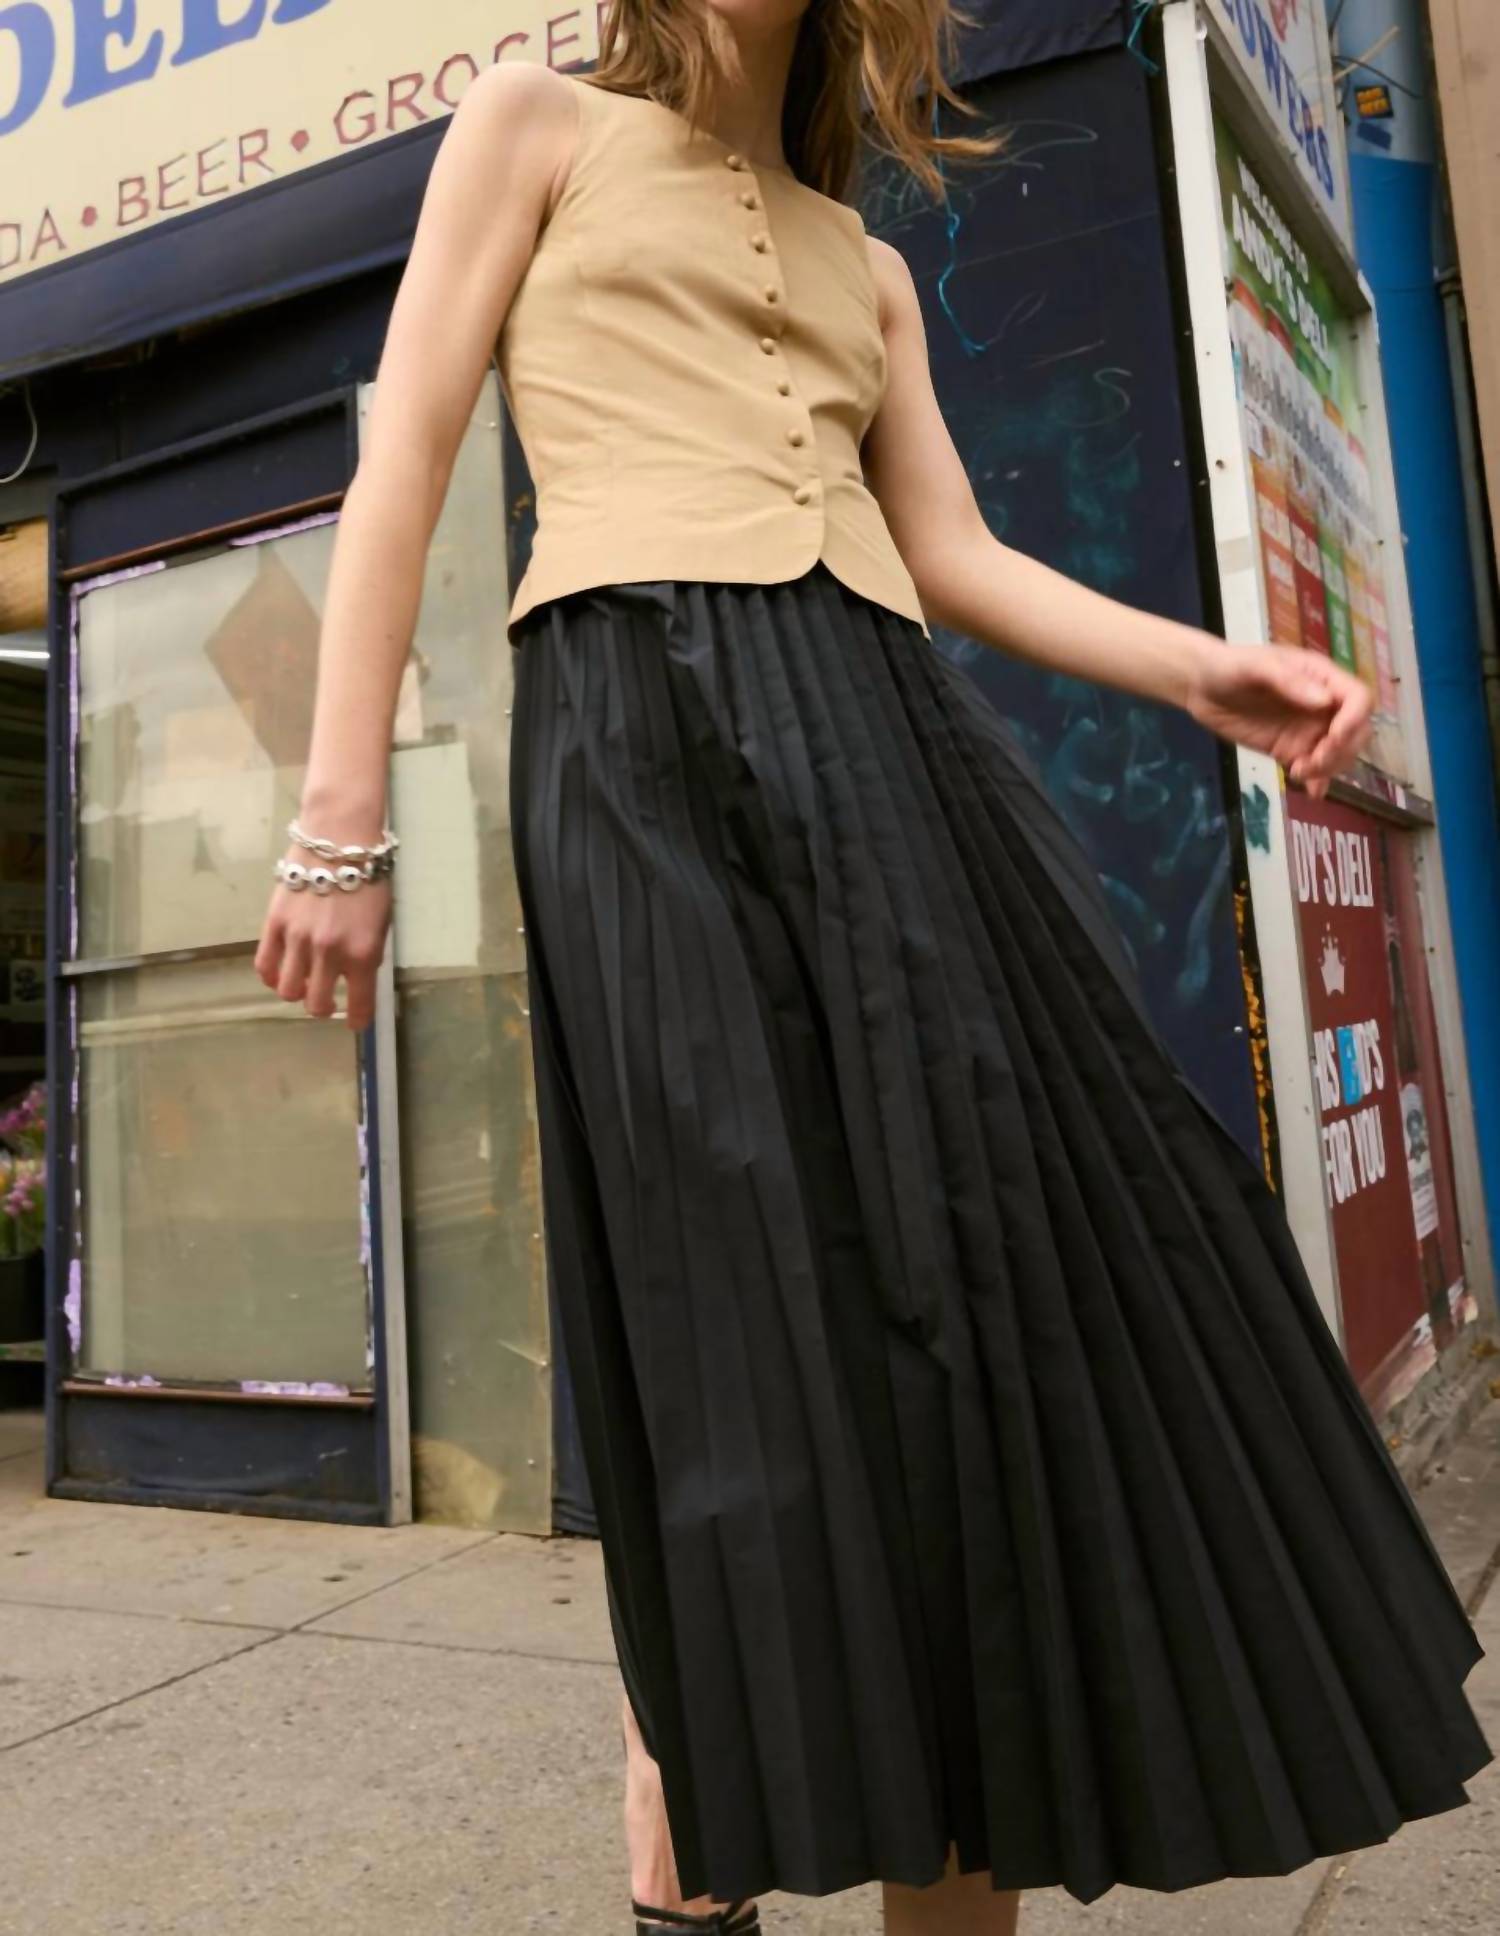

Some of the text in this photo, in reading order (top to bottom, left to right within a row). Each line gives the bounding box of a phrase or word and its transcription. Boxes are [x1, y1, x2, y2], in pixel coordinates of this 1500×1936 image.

[116, 128, 275, 226] BEER
[333, 0, 614, 144] GROCE
[1334, 829, 1375, 907] DELI
[1321, 1104, 1386, 1209] FOR YOU
